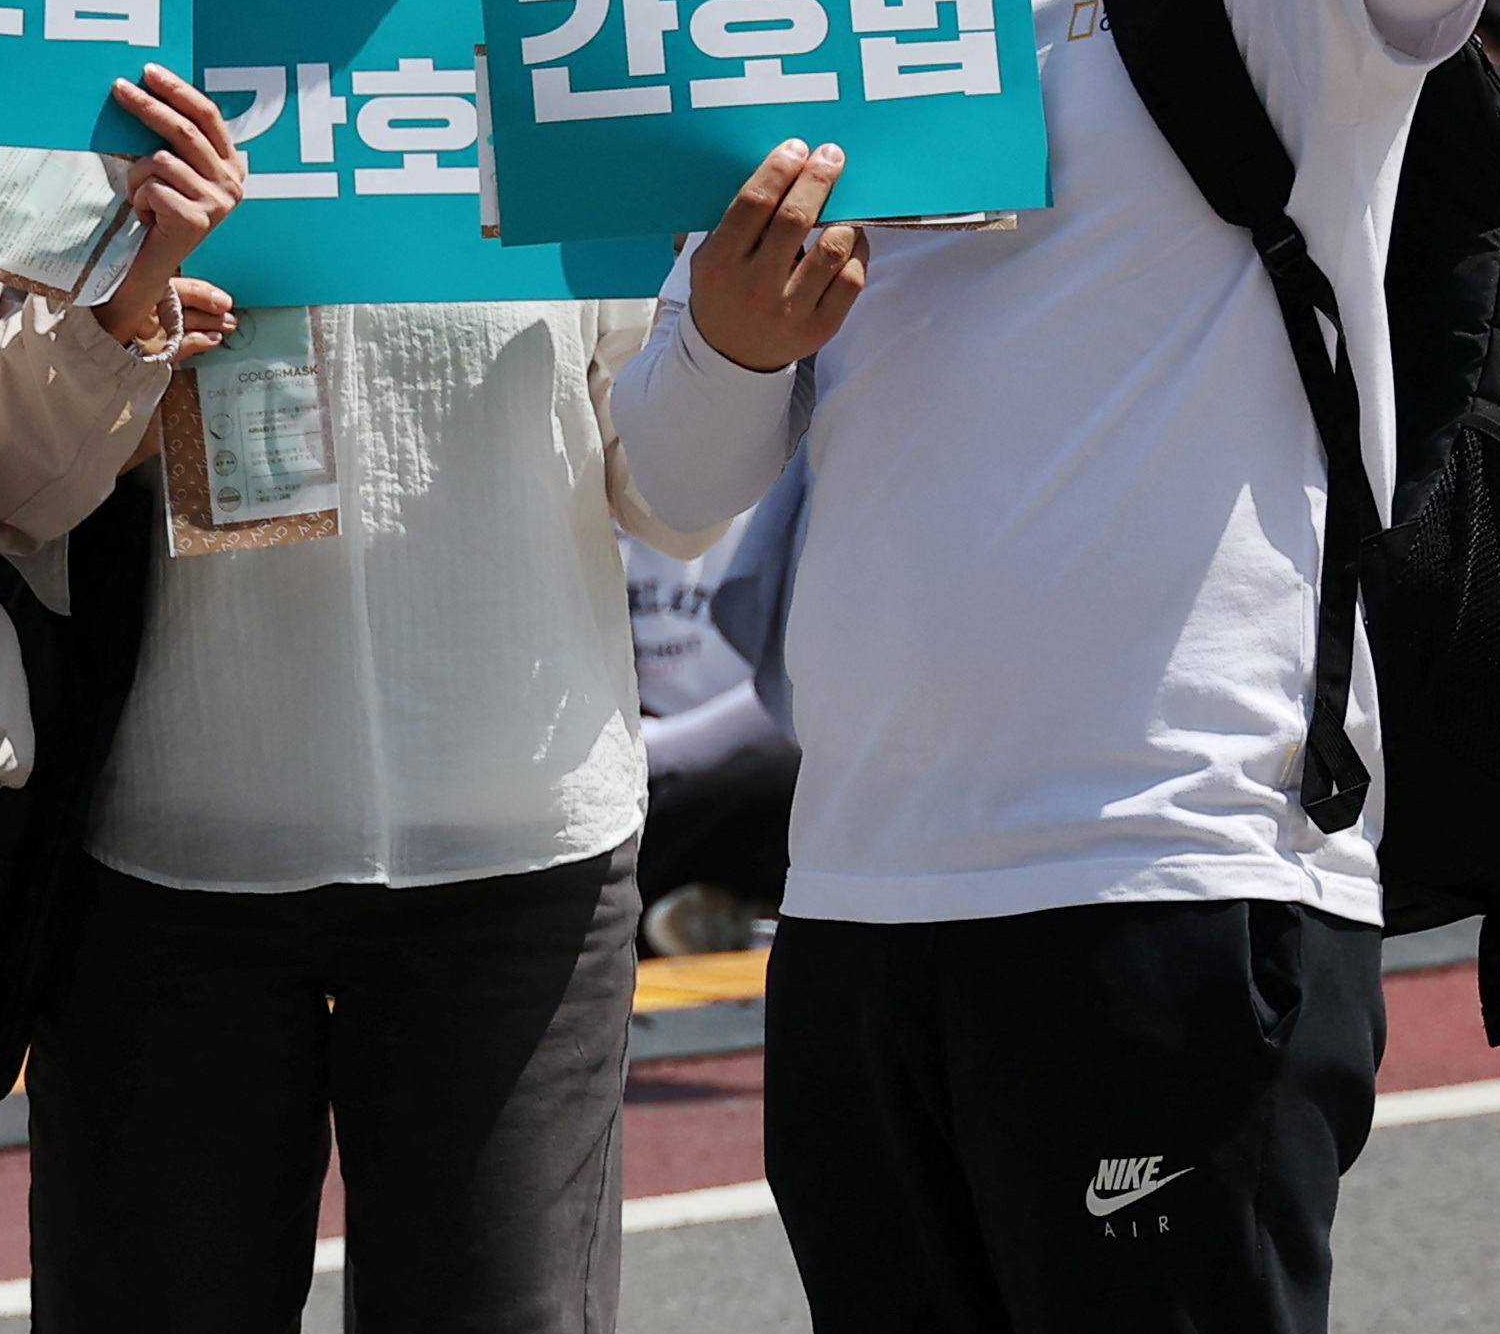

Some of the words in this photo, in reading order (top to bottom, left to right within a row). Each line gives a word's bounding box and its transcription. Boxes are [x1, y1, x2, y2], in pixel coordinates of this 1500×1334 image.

[204, 58, 481, 199] 간호
[238, 365, 318, 384] COLORMASK
[1095, 1155, 1164, 1191] NIKE
[1104, 1215, 1170, 1238] AIR
